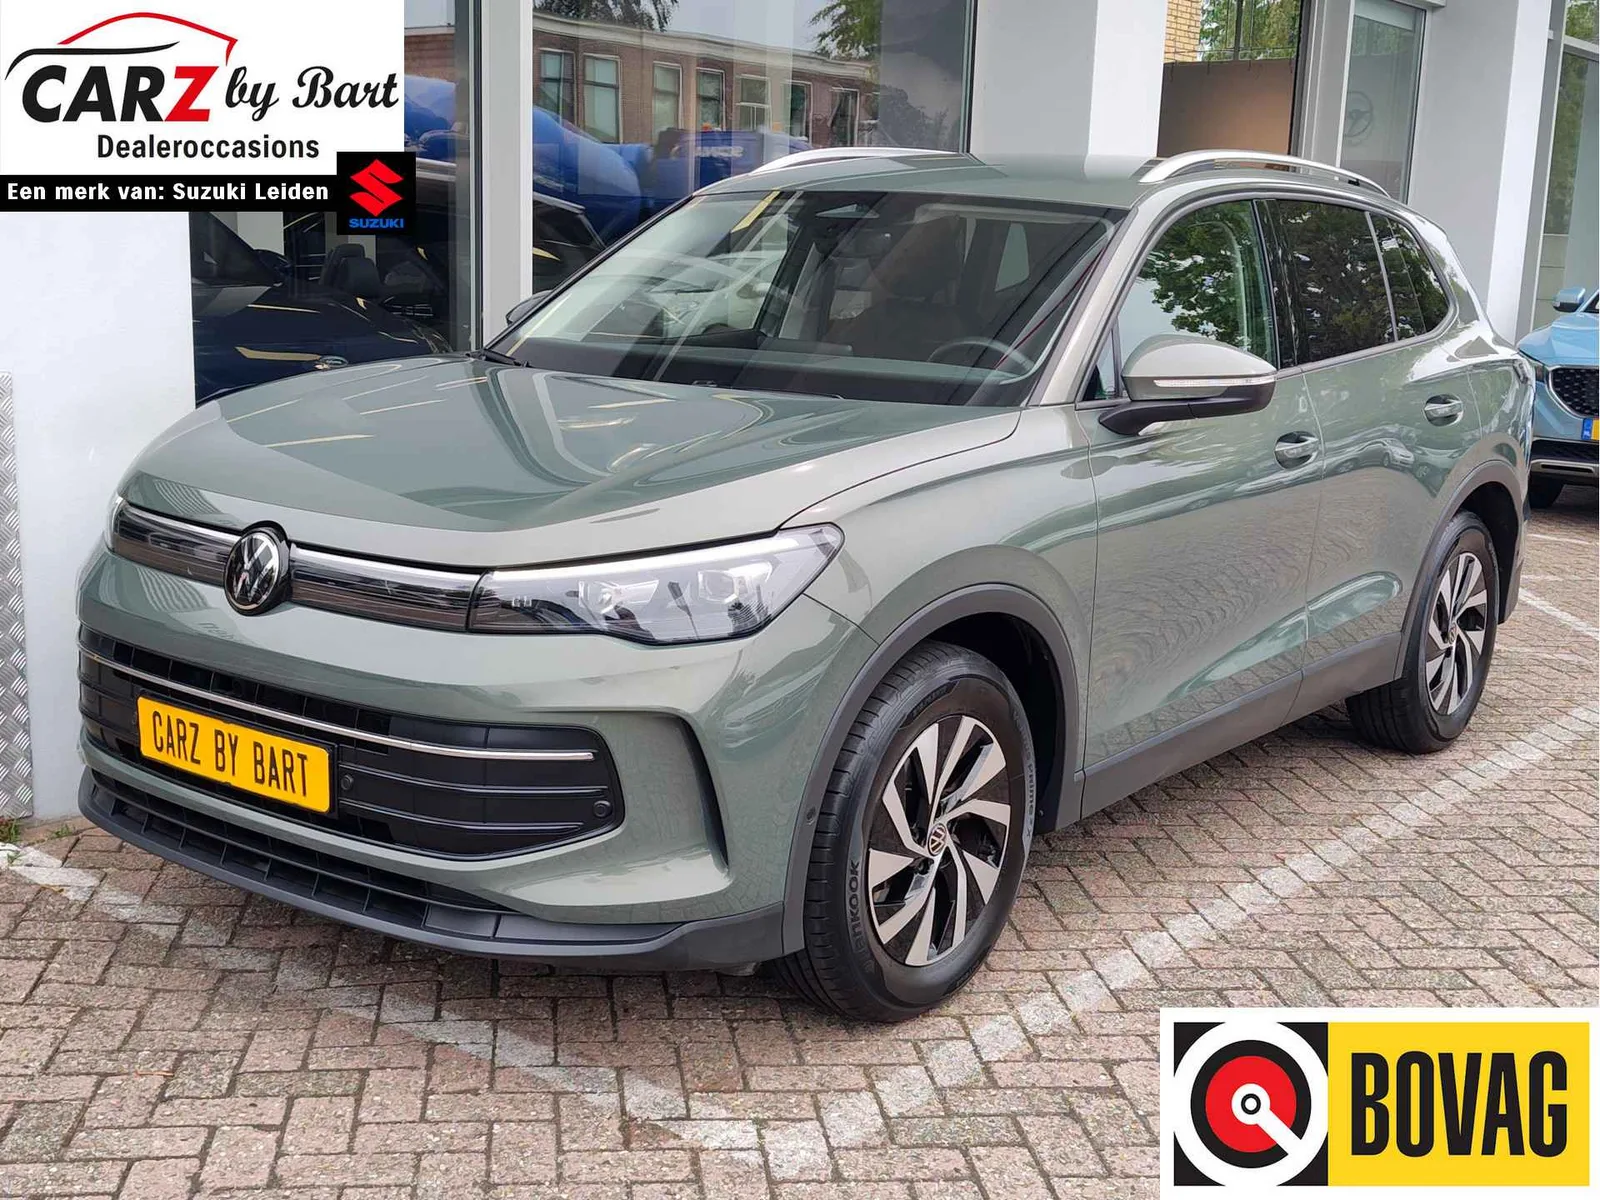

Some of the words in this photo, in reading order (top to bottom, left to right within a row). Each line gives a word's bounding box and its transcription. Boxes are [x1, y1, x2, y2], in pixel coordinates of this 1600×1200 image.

[152, 711, 201, 765] CARZ
[214, 729, 239, 777] BY
[253, 741, 308, 797] BART
